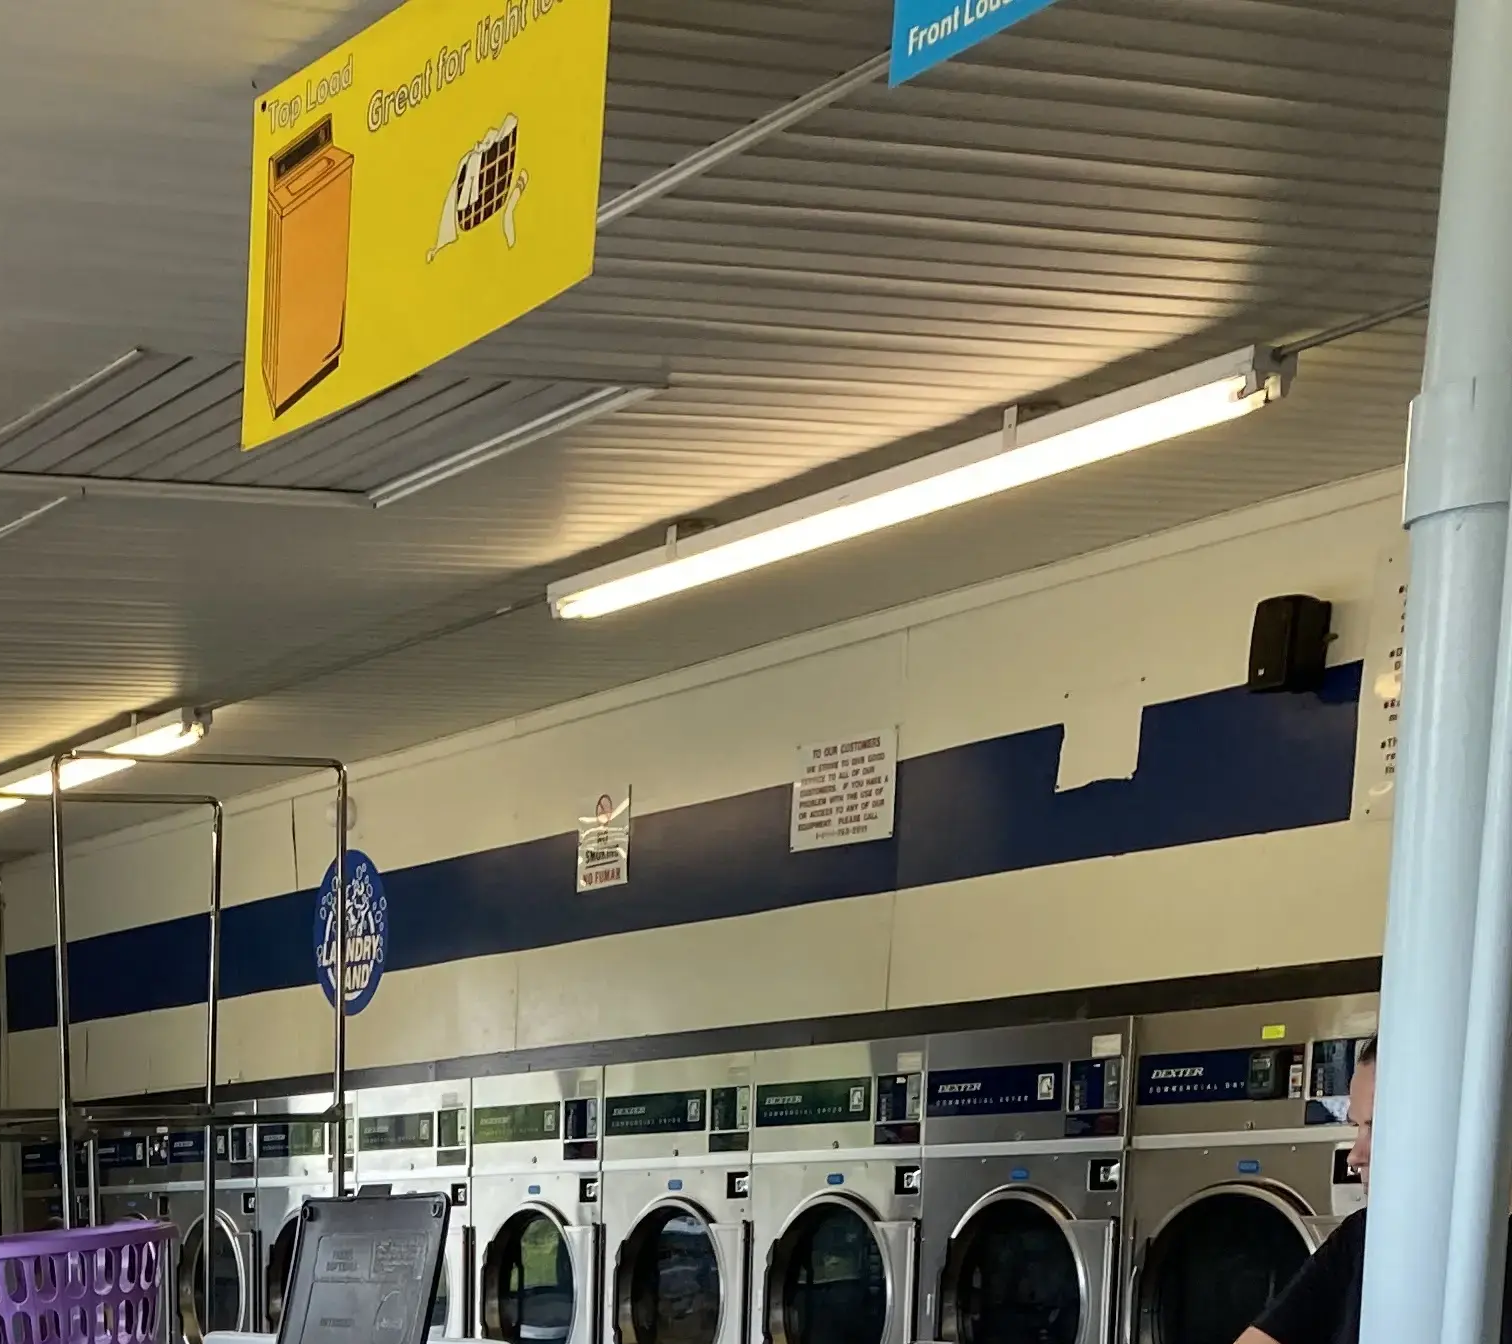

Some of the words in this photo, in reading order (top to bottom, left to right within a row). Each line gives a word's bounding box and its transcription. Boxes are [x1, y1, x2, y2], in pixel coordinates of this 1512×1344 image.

[908, 5, 960, 56] Front
[964, 0, 1013, 26] Loa
[367, 59, 433, 132] Great
[437, 40, 471, 91] for
[476, 0, 530, 63] light
[267, 99, 301, 134] Top
[306, 54, 354, 113] Load
[322, 933, 381, 967] LANDRY
[344, 964, 370, 991] AND
[938, 1082, 982, 1094] DEXTER
[1150, 1066, 1205, 1080] DEXTER
